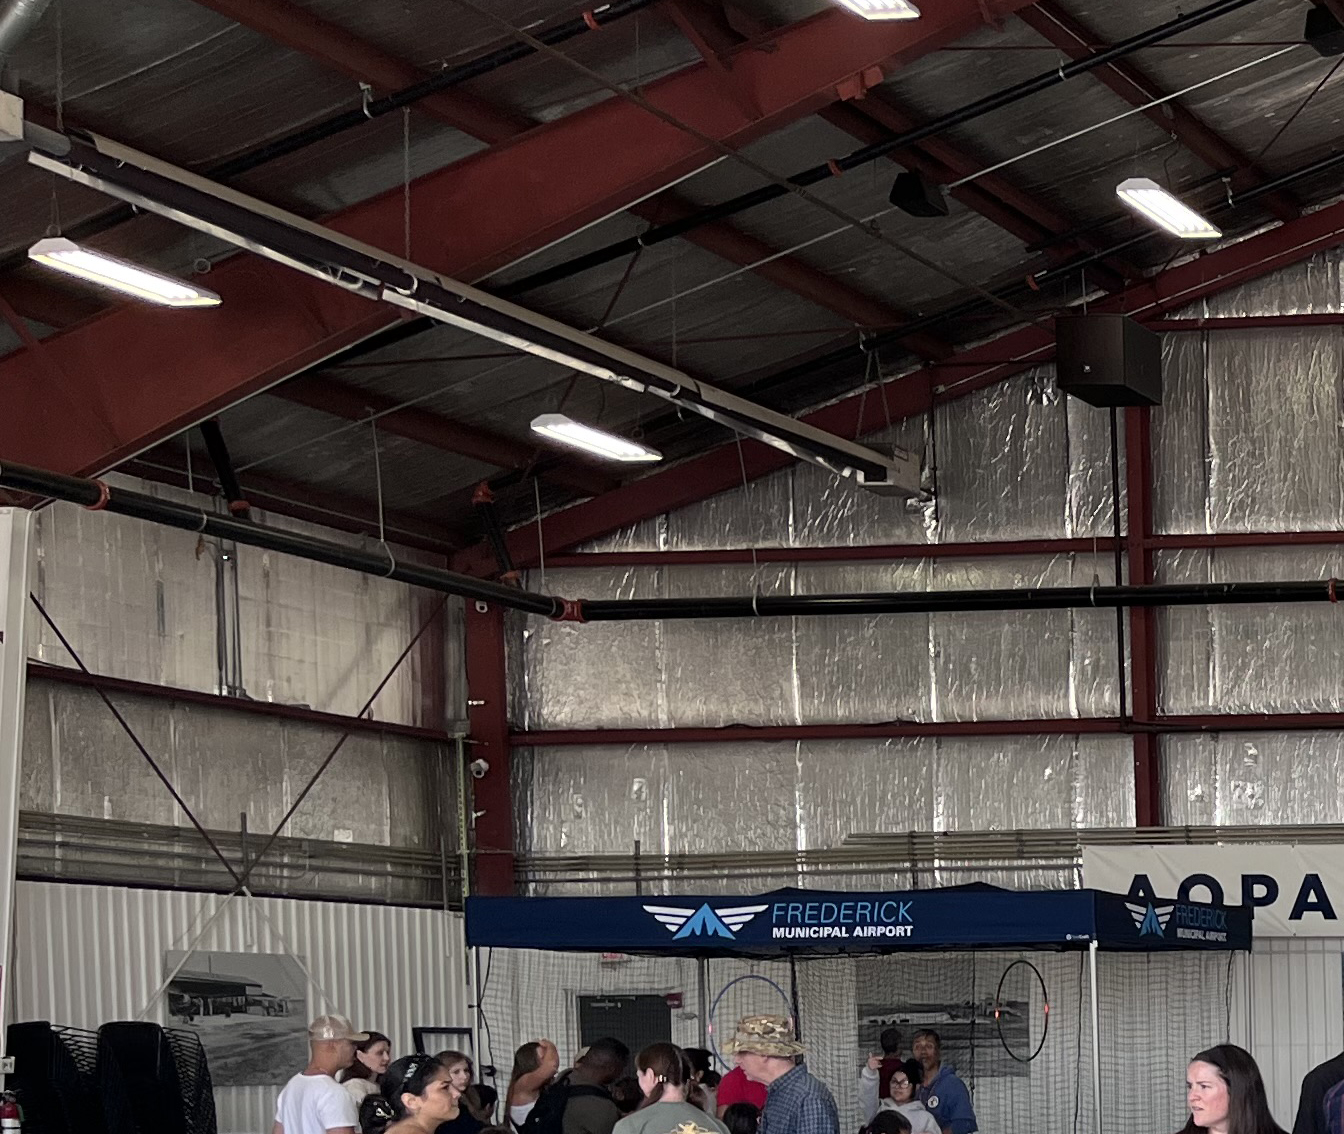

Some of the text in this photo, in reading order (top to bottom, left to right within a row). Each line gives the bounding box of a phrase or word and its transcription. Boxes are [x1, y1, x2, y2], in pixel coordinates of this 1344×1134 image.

[1128, 873, 1338, 921] AOPA
[772, 901, 914, 924] FREDERICK
[1176, 904, 1228, 930] FREDERICK
[772, 925, 914, 939] MUNICIPAL AIRPORT
